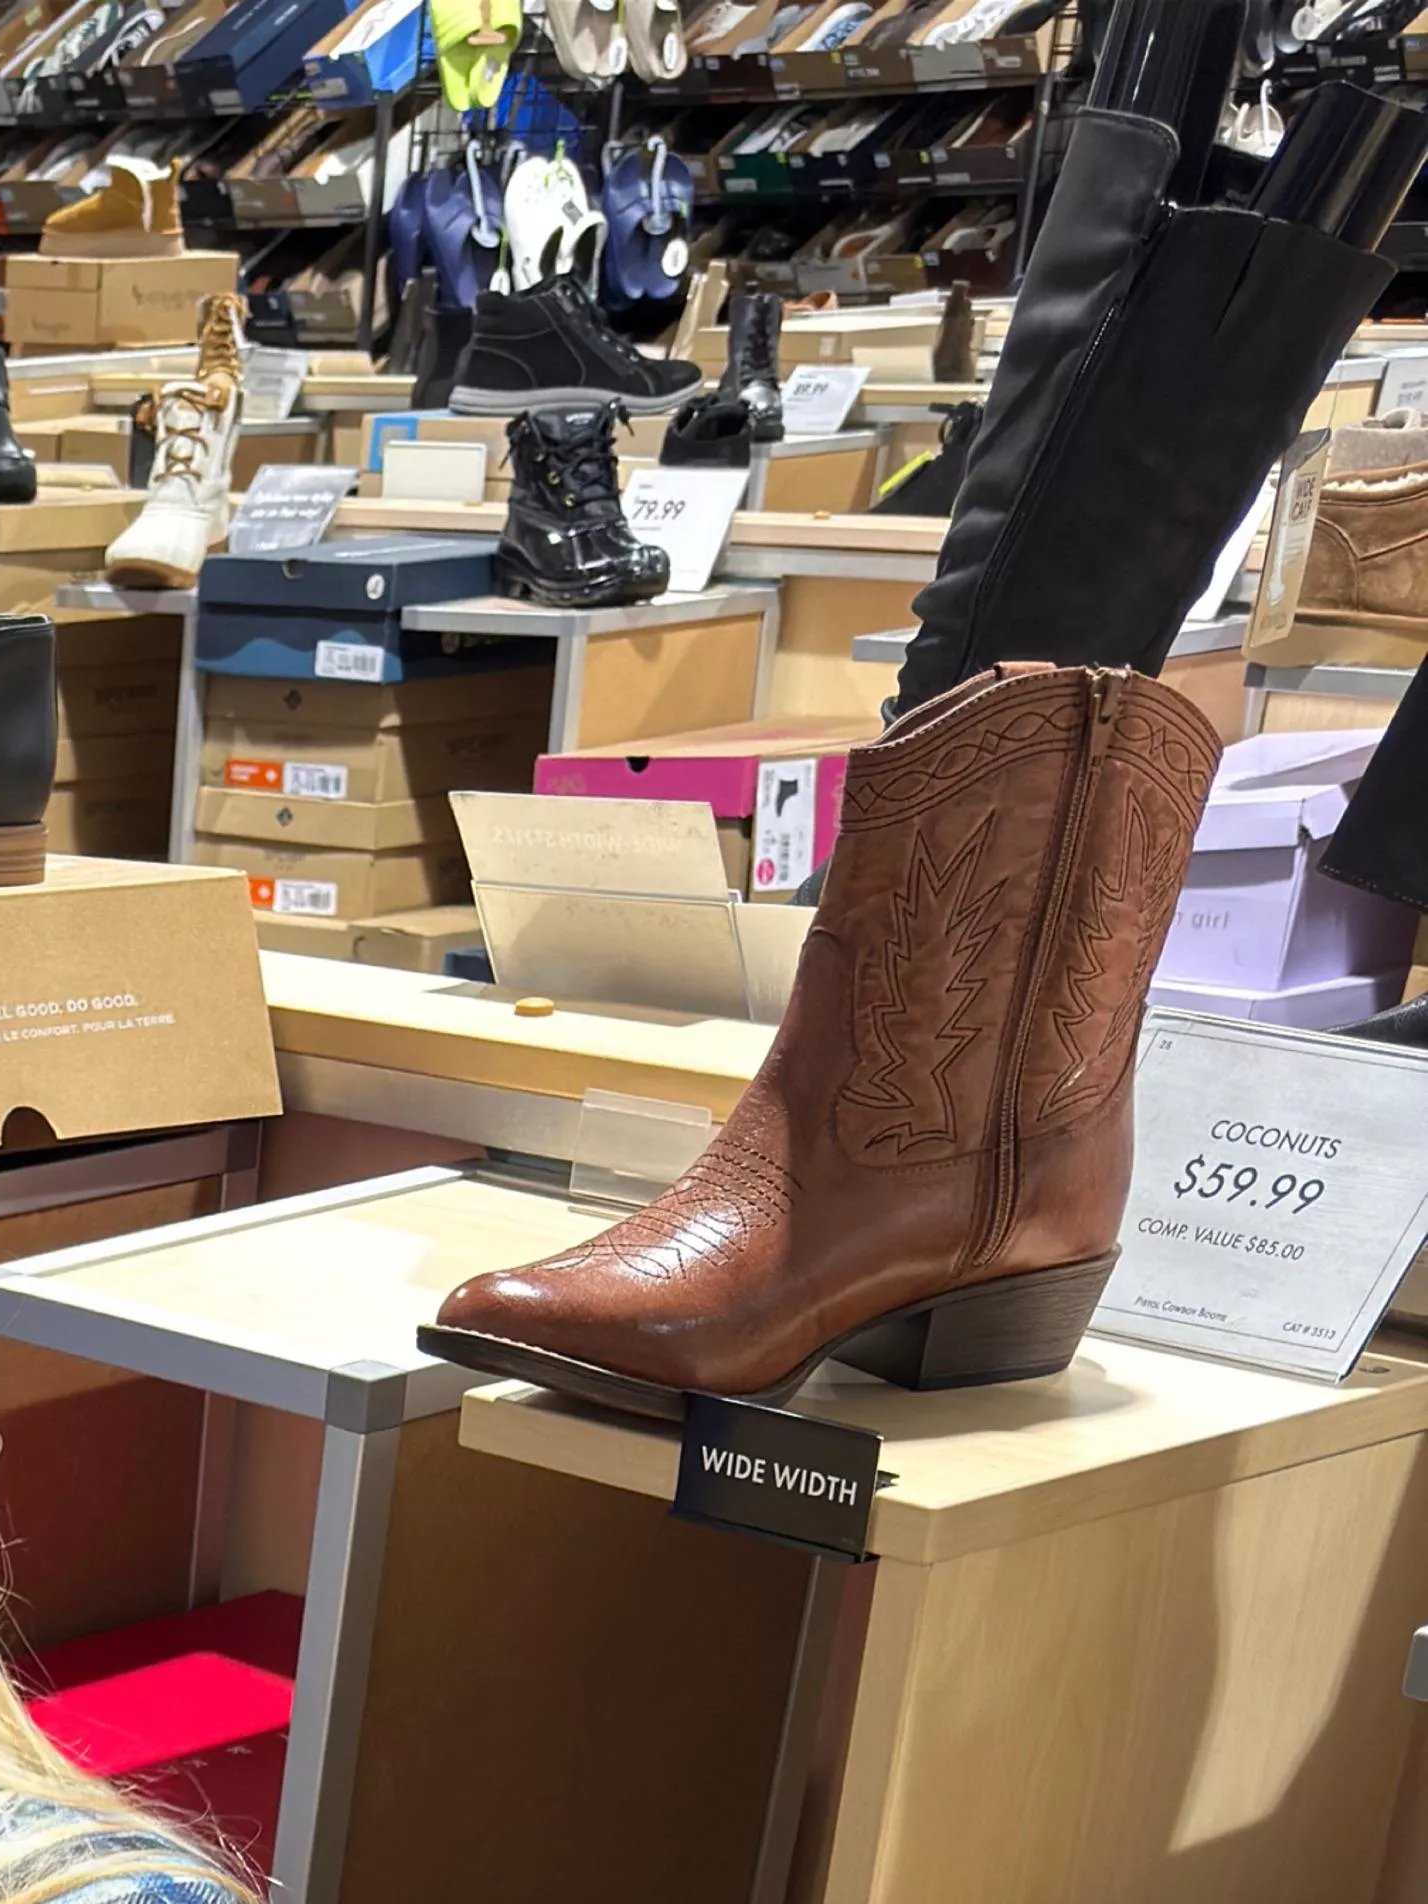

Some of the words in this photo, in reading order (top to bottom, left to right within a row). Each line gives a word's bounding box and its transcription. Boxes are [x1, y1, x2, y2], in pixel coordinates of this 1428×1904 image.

[1191, 910, 1230, 931] girl
[15, 1001, 63, 1019] GOOD.
[66, 998, 88, 1014] DO
[91, 993, 139, 1011] GOOD.
[3, 1029, 20, 1043] LE
[82, 1019, 116, 1034] POUR
[118, 1017, 134, 1031] LA
[1210, 1118, 1342, 1160] COCONUTS
[1173, 1153, 1325, 1215] $59.99
[1137, 1217, 1189, 1241] COMP.
[1194, 1225, 1245, 1250] VALUE
[1244, 1235, 1305, 1262] $85.00
[1282, 1321, 1303, 1334] CAT
[701, 1444, 767, 1485] WIDE
[773, 1461, 858, 1507] WIDTH
